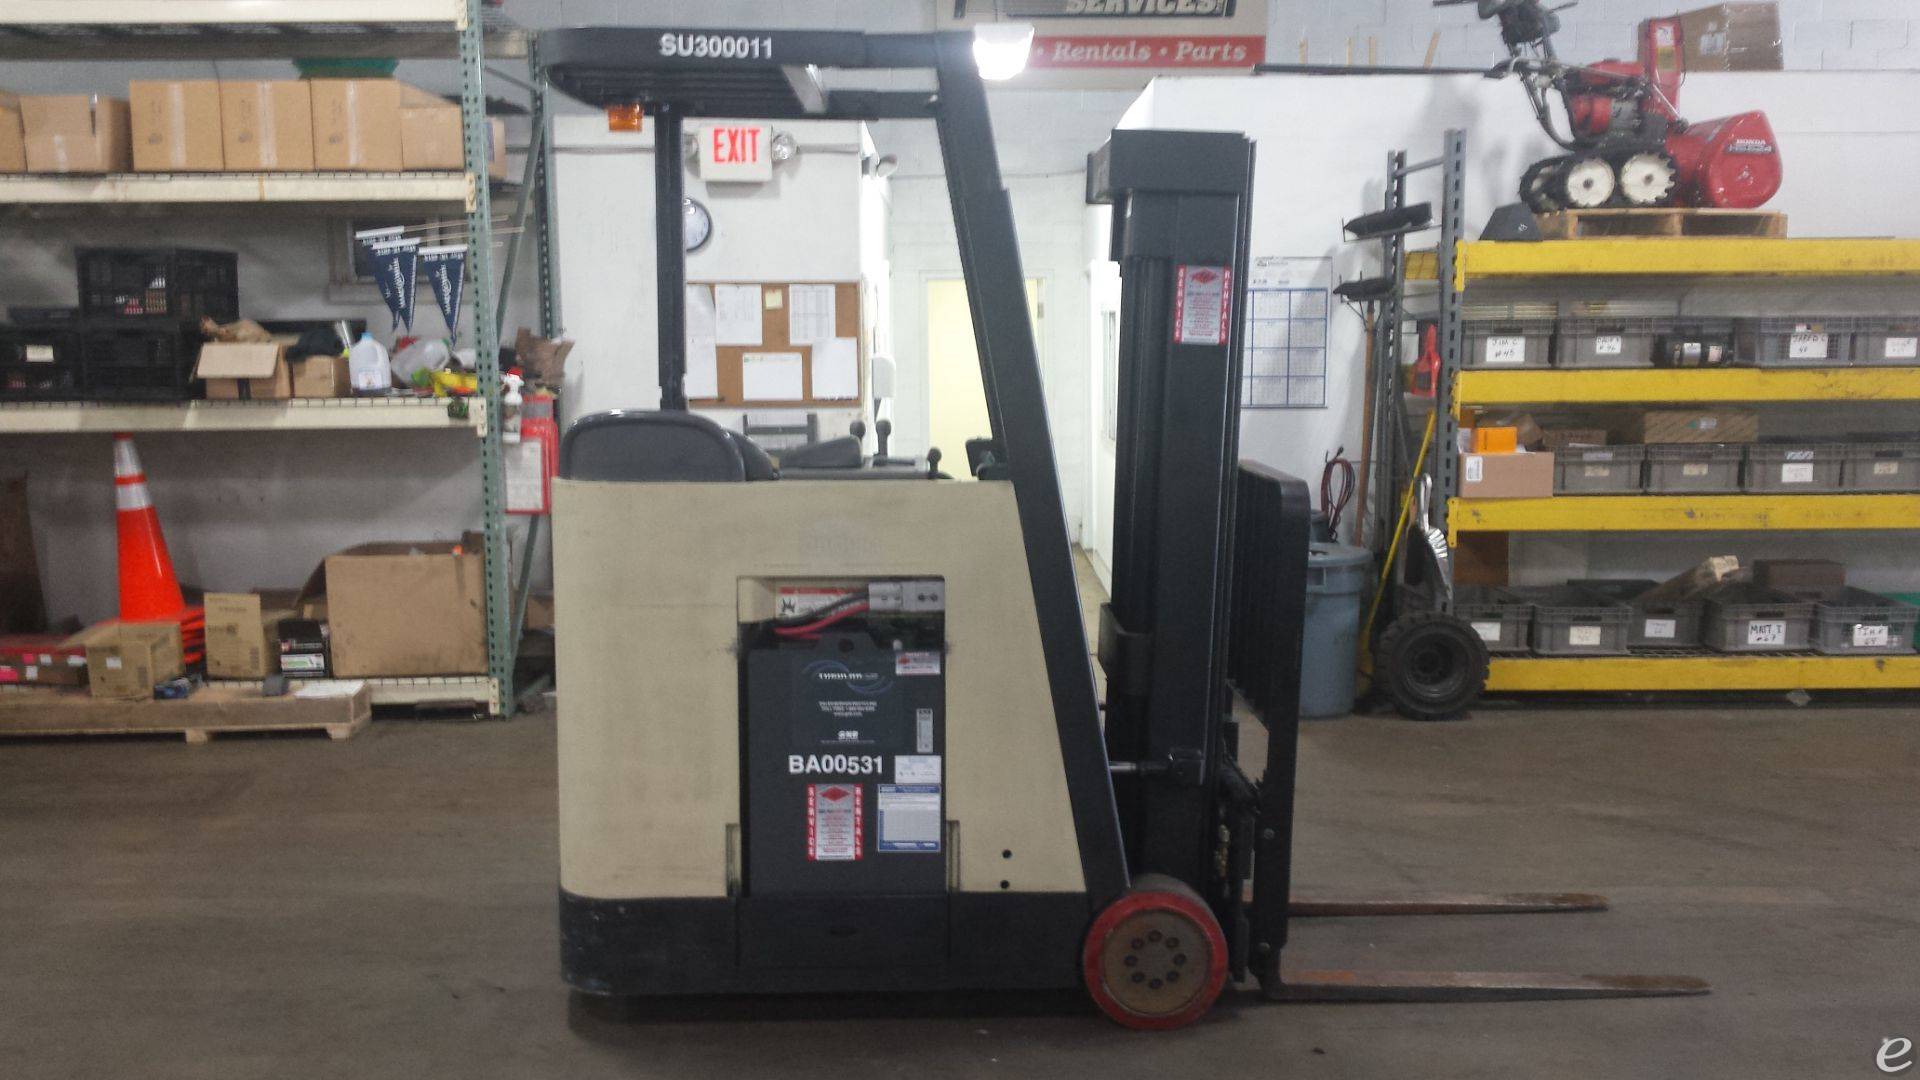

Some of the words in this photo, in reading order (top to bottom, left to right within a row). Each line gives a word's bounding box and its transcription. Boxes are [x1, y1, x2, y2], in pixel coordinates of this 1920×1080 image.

[660, 33, 773, 59] SU300011
[1052, 40, 1150, 62] Rentals
[1174, 40, 1247, 62] Parts
[712, 127, 760, 163] EXIT
[1220, 270, 1230, 340] RENTALS
[1750, 623, 1772, 635] MATT
[788, 753, 883, 775] BA00531
